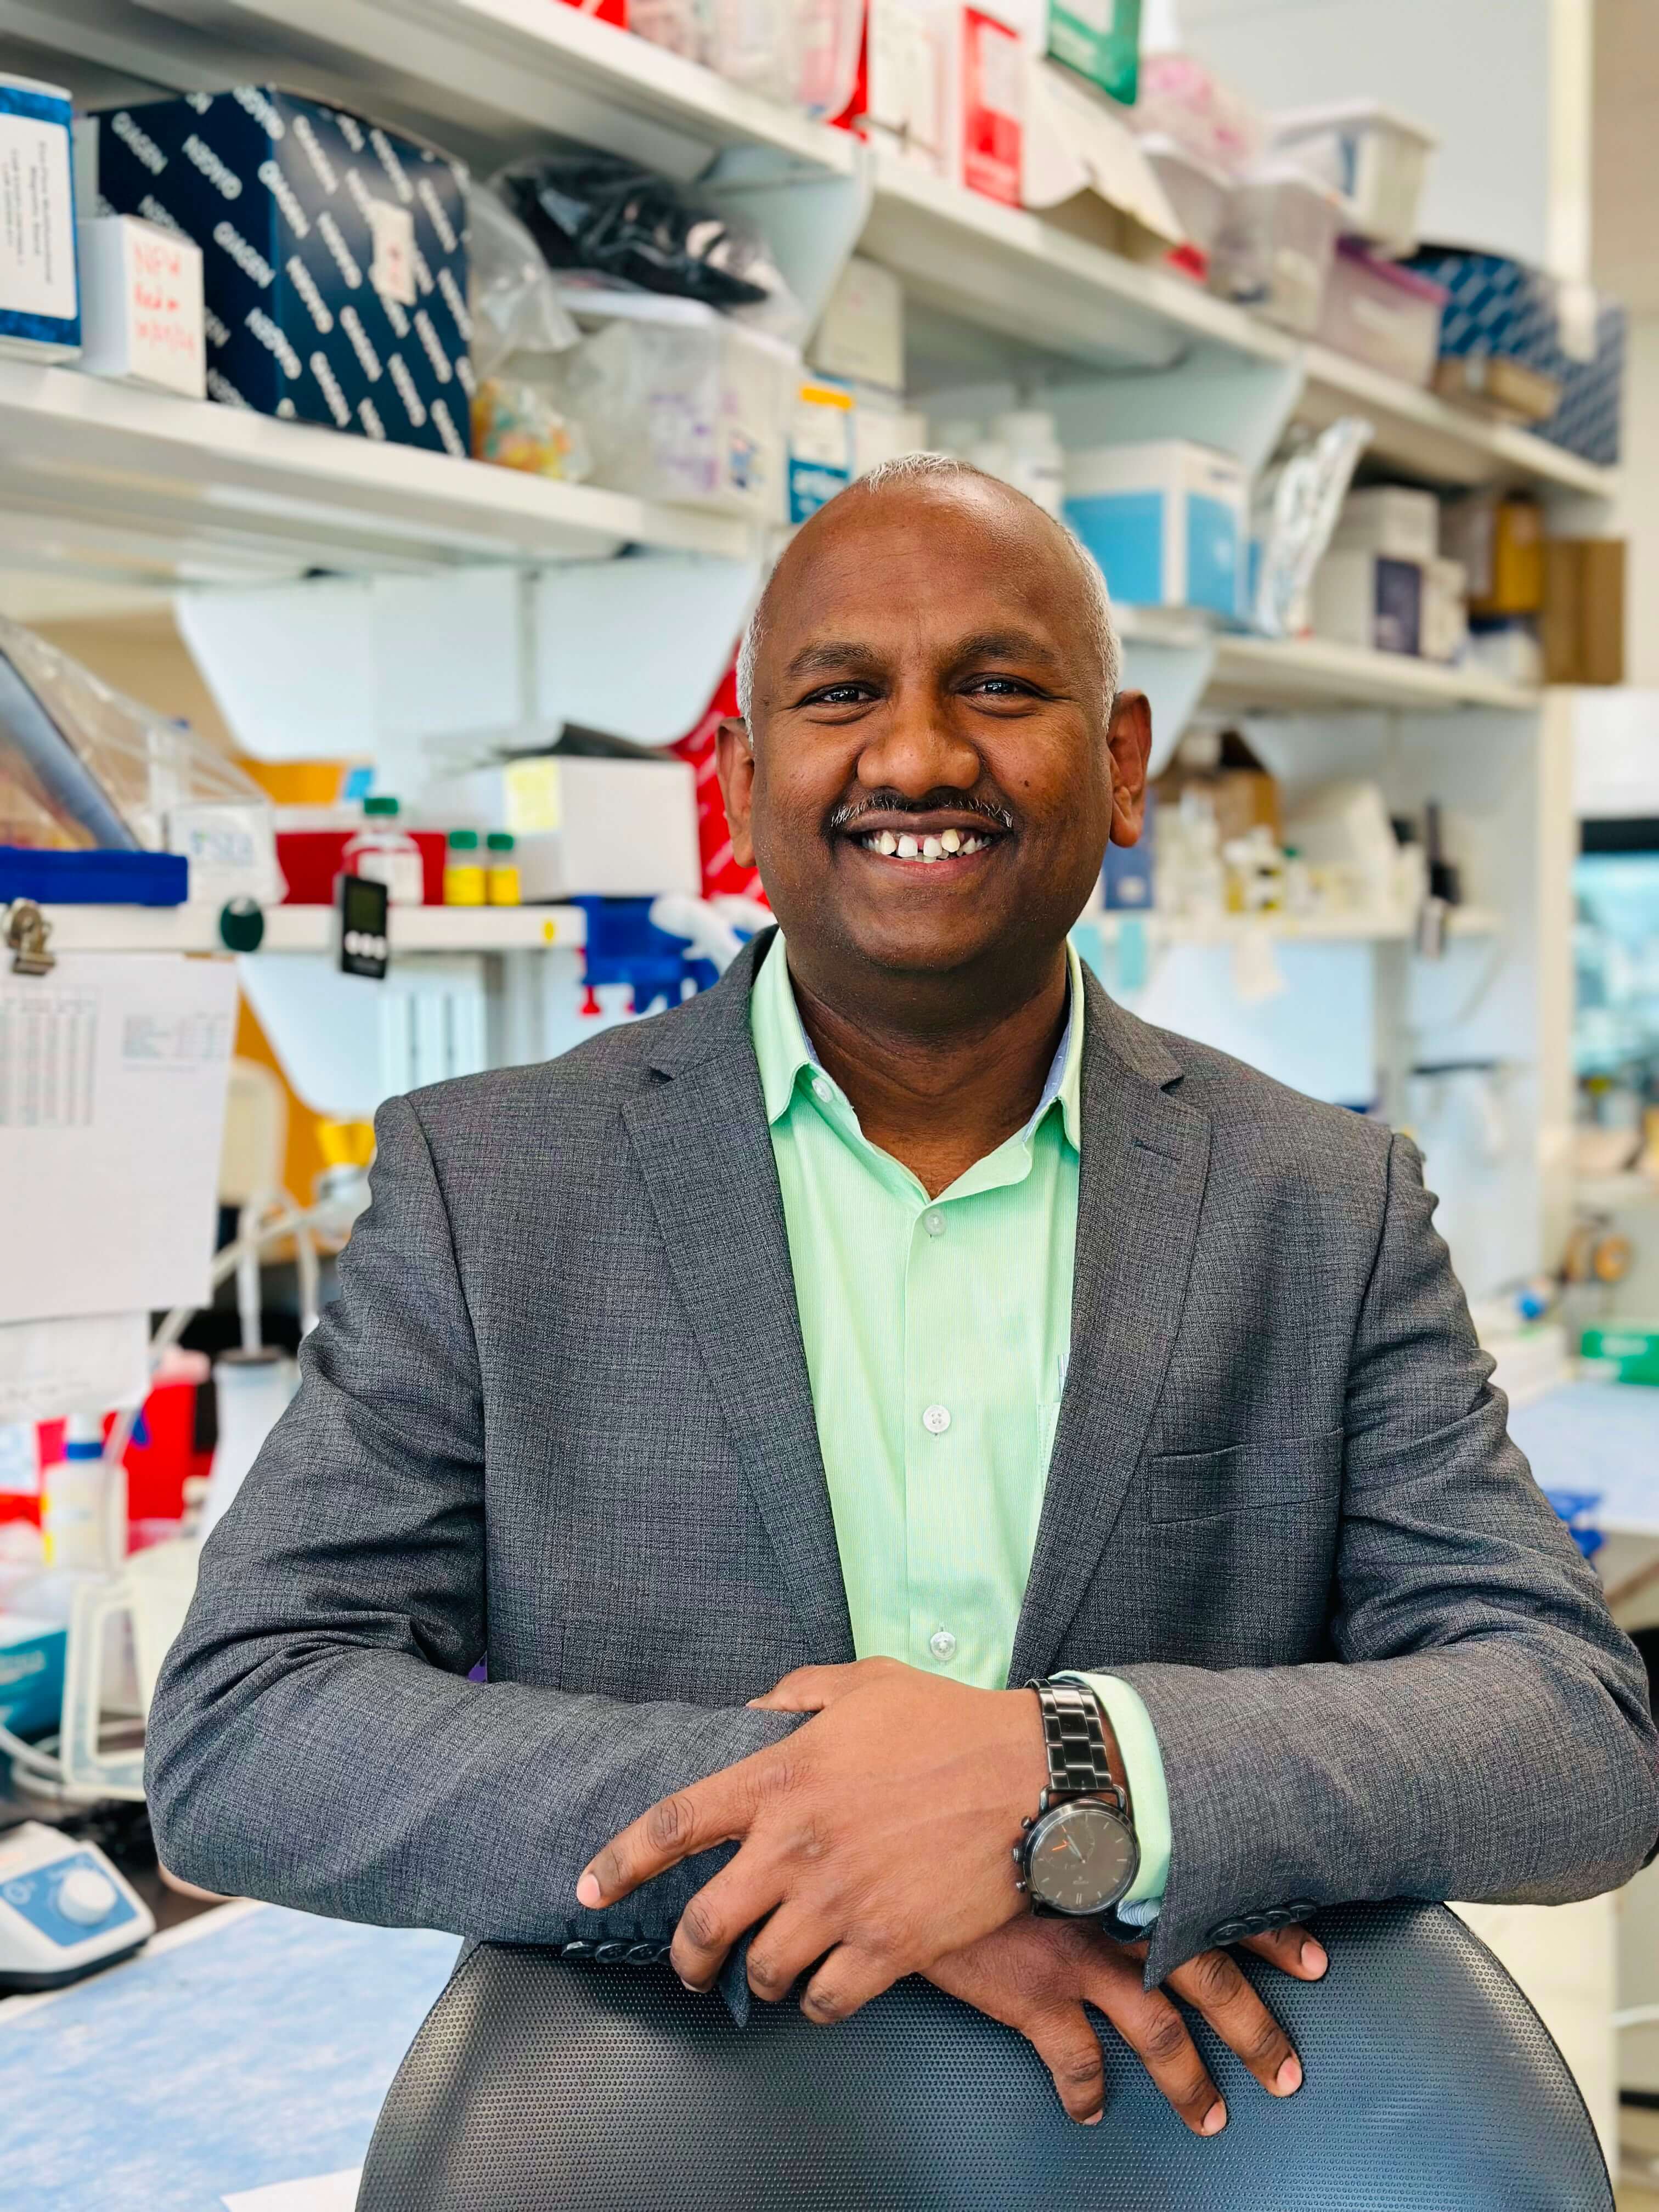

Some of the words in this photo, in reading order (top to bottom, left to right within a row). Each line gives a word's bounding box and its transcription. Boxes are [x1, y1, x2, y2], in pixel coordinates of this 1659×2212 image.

[111, 111, 168, 176] QIAGEN
[181, 133, 242, 200] QIAGEN
[213, 221, 276, 289] QIAGEN
